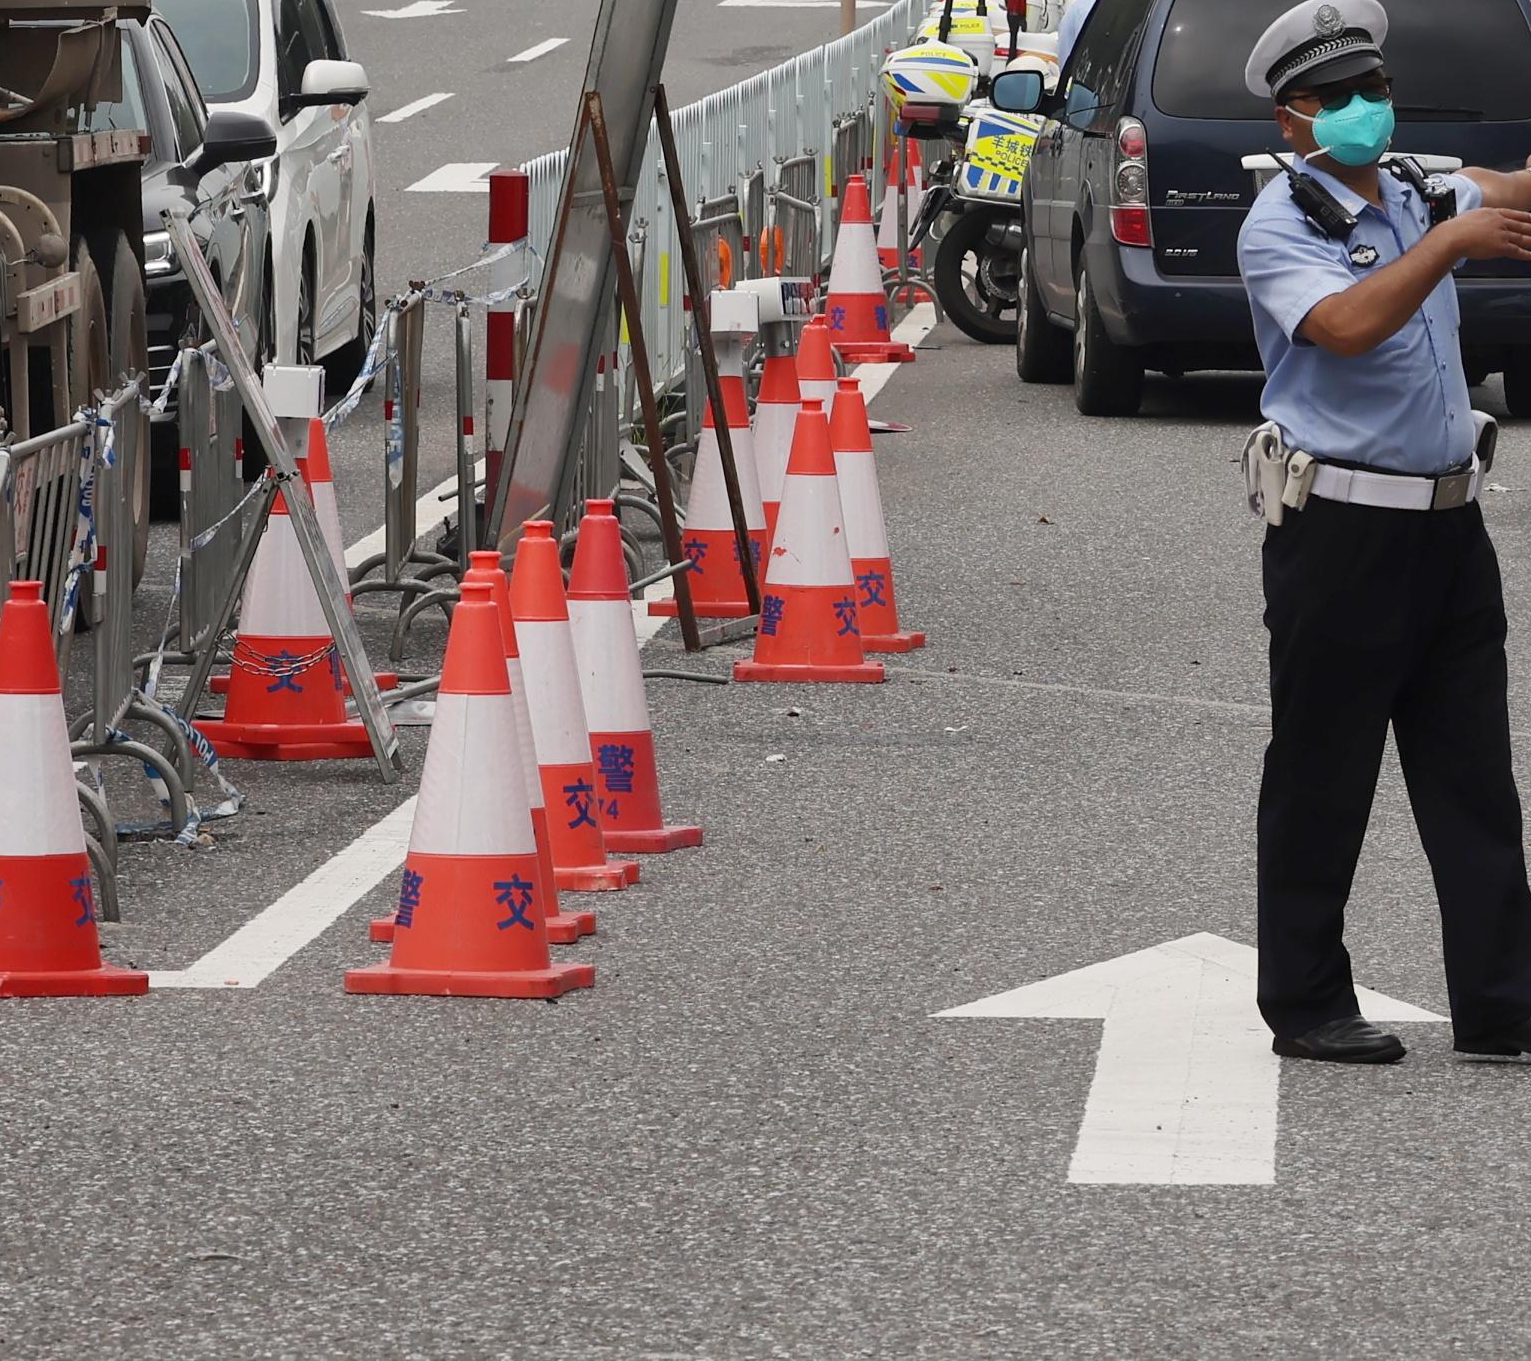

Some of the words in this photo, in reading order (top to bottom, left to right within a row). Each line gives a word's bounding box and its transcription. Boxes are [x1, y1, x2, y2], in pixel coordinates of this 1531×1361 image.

[856, 570, 886, 607] 交
[833, 596, 860, 636] 交
[563, 778, 596, 829] 交
[493, 874, 535, 931] 交
